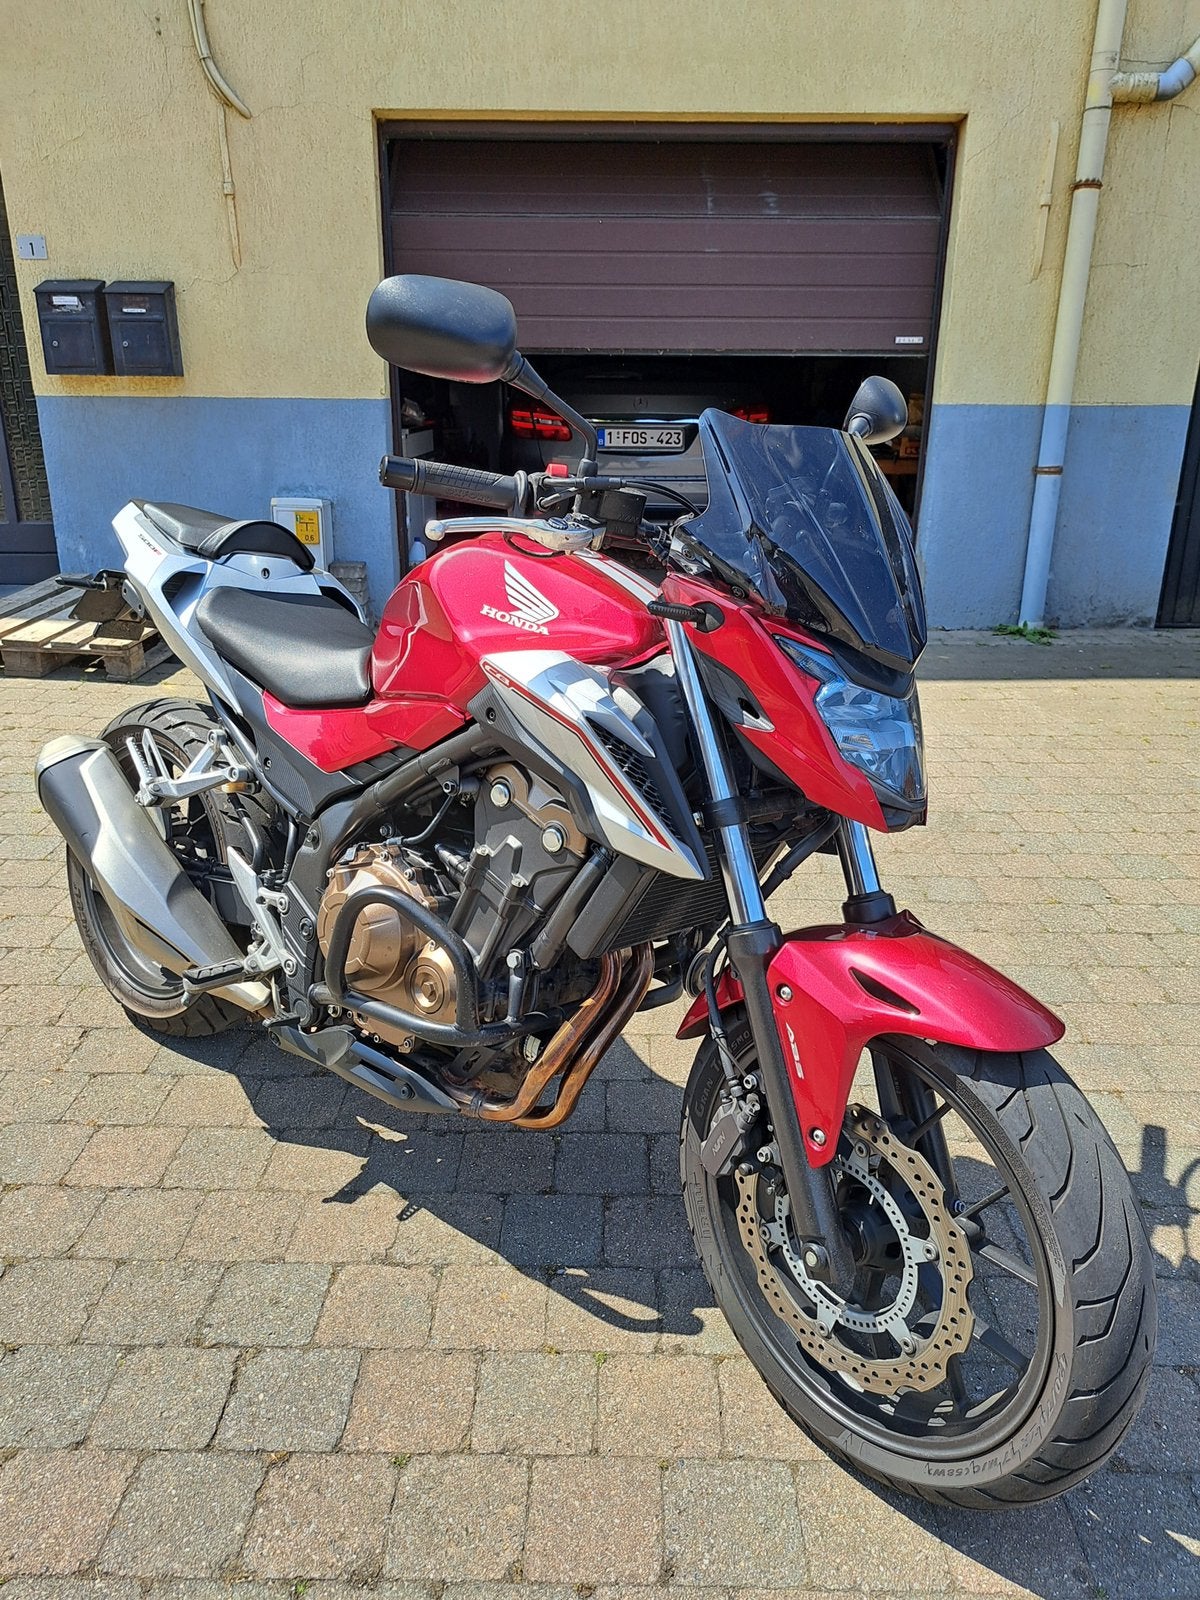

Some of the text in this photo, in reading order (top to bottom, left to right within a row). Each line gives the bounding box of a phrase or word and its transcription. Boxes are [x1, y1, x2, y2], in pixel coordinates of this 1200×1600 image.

[29, 242, 35, 257] 1
[480, 604, 549, 636] HONDA
[484, 664, 510, 687] CB
[785, 1021, 805, 1080] ABS
[695, 1078, 714, 1118] GRAN
